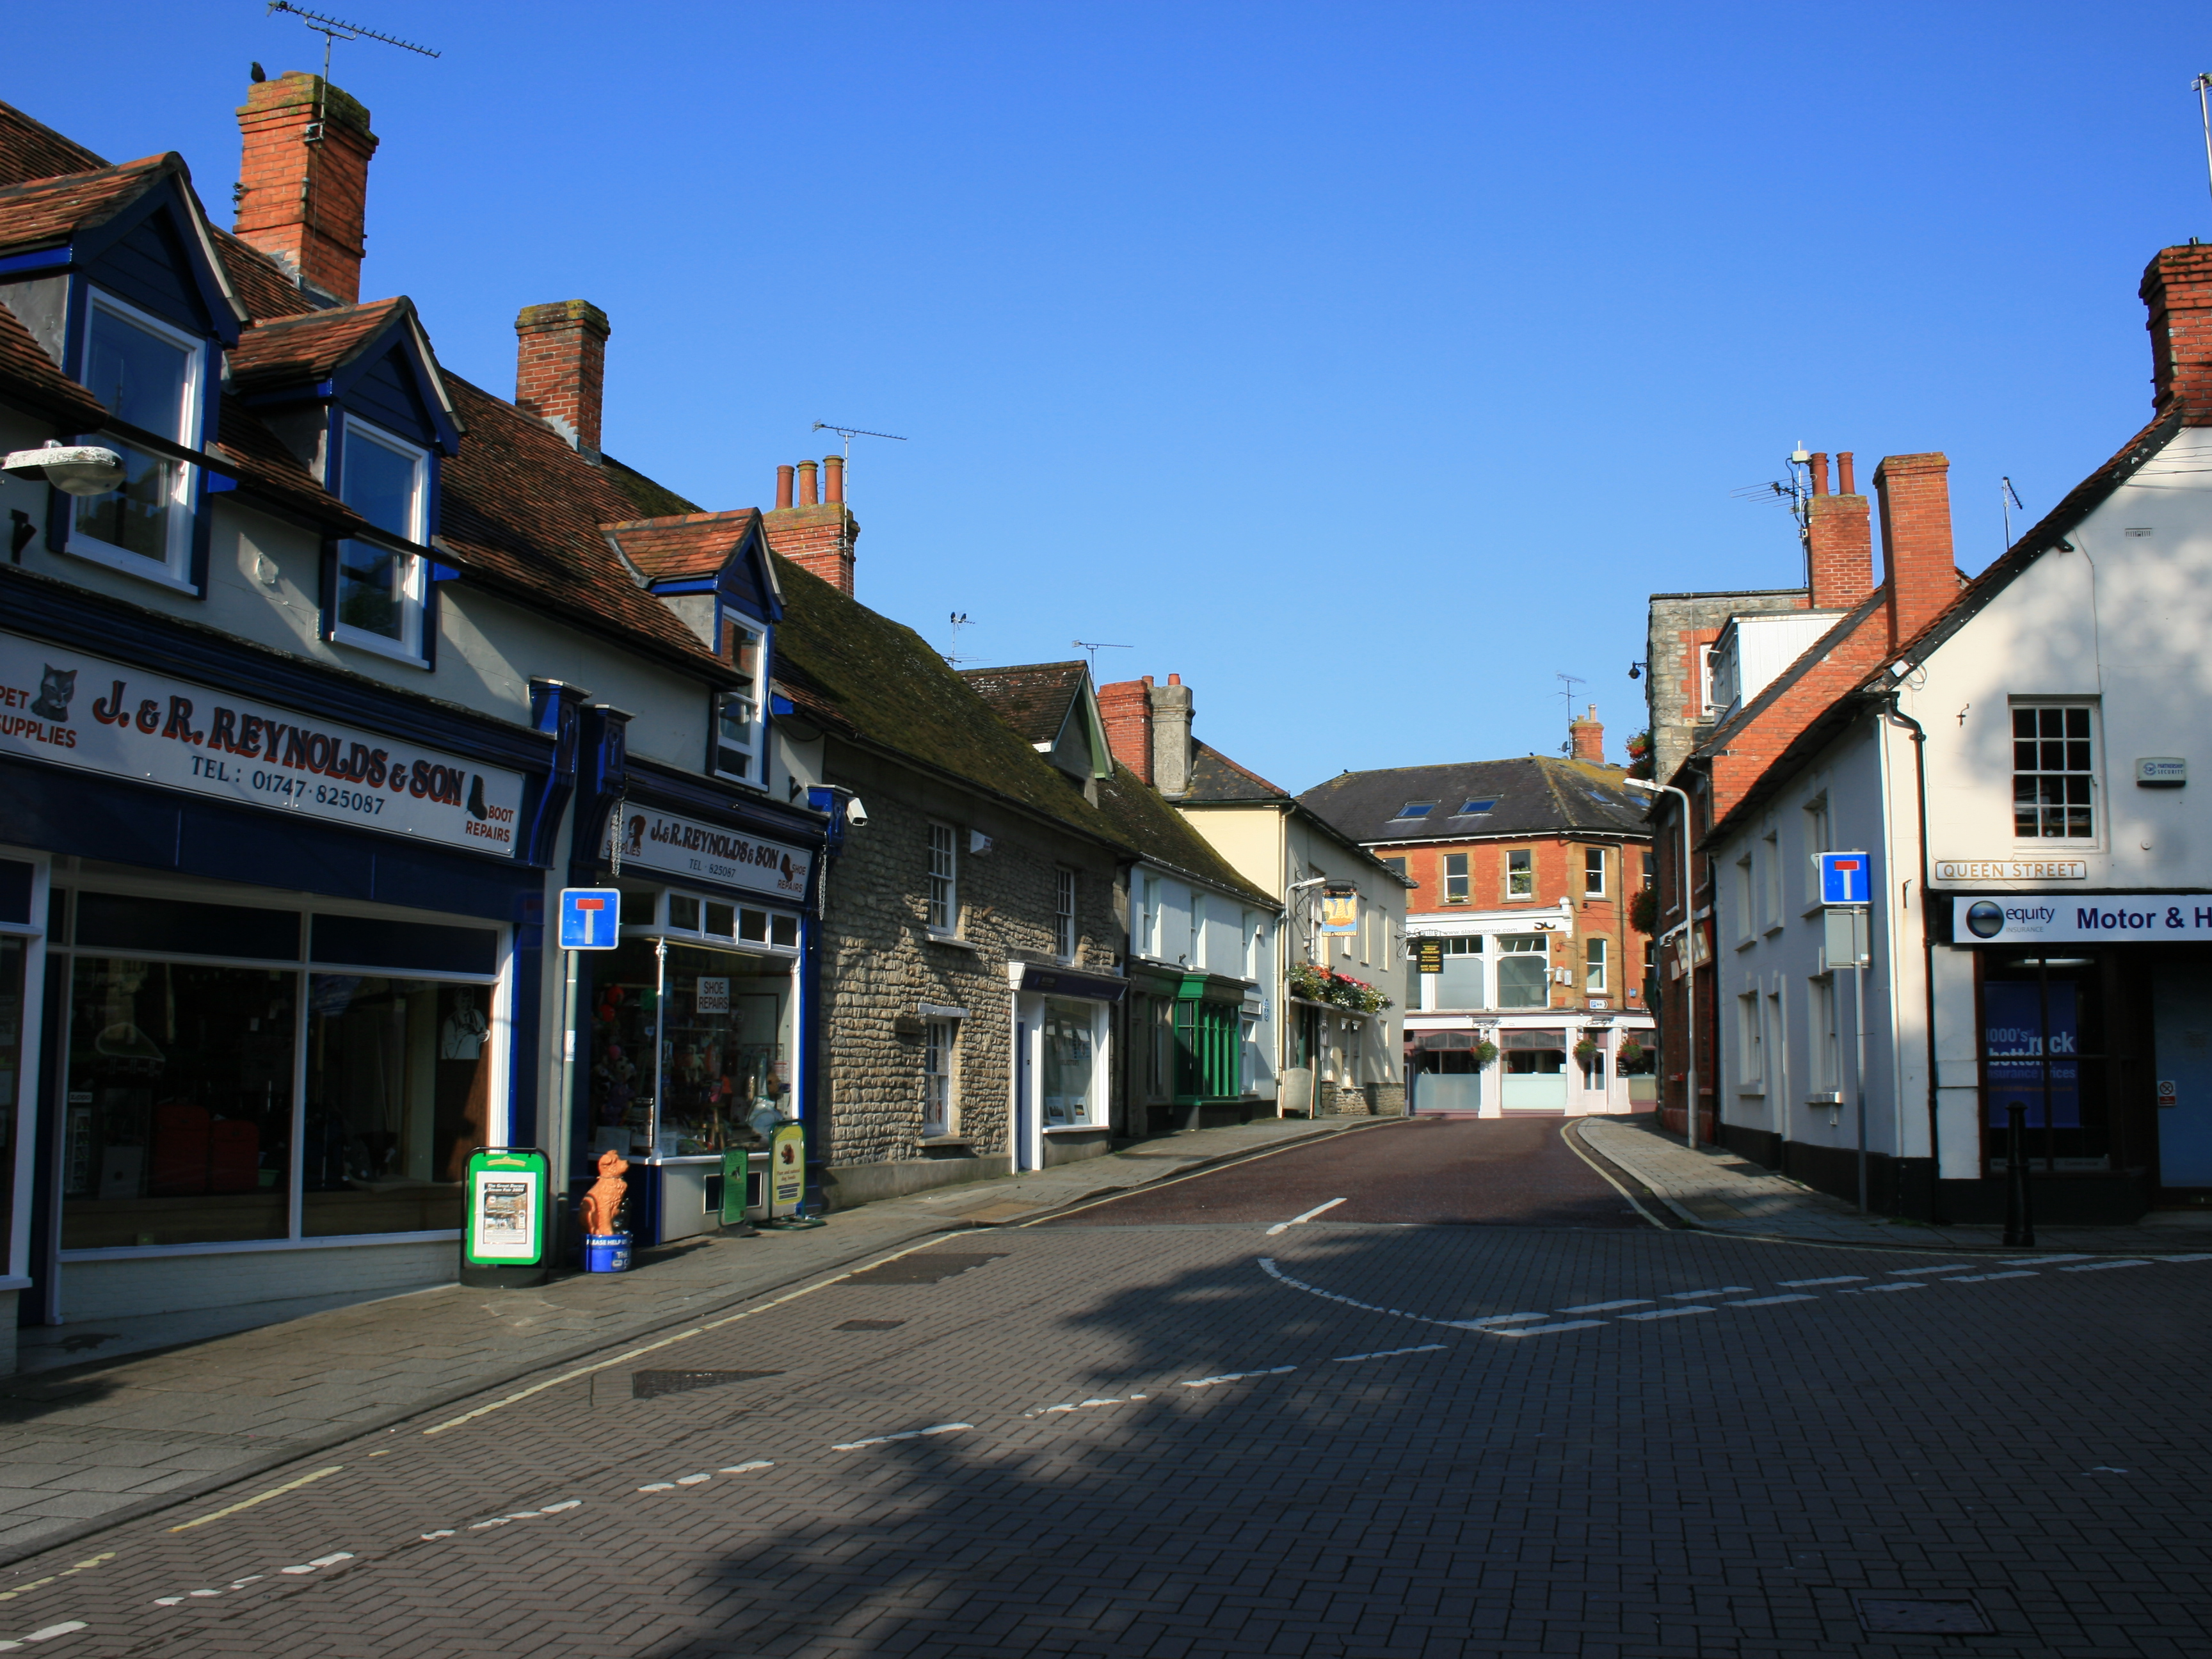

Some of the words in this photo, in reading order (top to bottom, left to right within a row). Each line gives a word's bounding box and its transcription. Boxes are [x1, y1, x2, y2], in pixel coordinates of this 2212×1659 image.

[0, 714, 77, 748] UPPLIES
[136, 700, 161, 734] &
[207, 707, 389, 788] REYNOLDS
[389, 763, 408, 792] &
[409, 759, 466, 807] SON
[488, 805, 513, 823] BOOT
[466, 821, 510, 842] REPAIRS
[606, 840, 641, 857] SPLIES
[681, 826, 749, 863] REYNOLDS
[755, 845, 780, 869] SON
[709, 863, 737, 879] 825087
[792, 863, 806, 876] SHOE
[1944, 864, 2004, 878] QUEEN
[2012, 863, 2078, 878] STREET
[777, 879, 803, 893] REPAIRS
[2005, 906, 2055, 924] equity
[2076, 908, 2156, 929] Motor
[2165, 906, 2185, 929] &
[704, 981, 724, 994] SHOE
[698, 997, 728, 1009] REPAIRS
[1988, 1048, 2052, 1066] botto
[1987, 1068, 2038, 1079] nsurance
